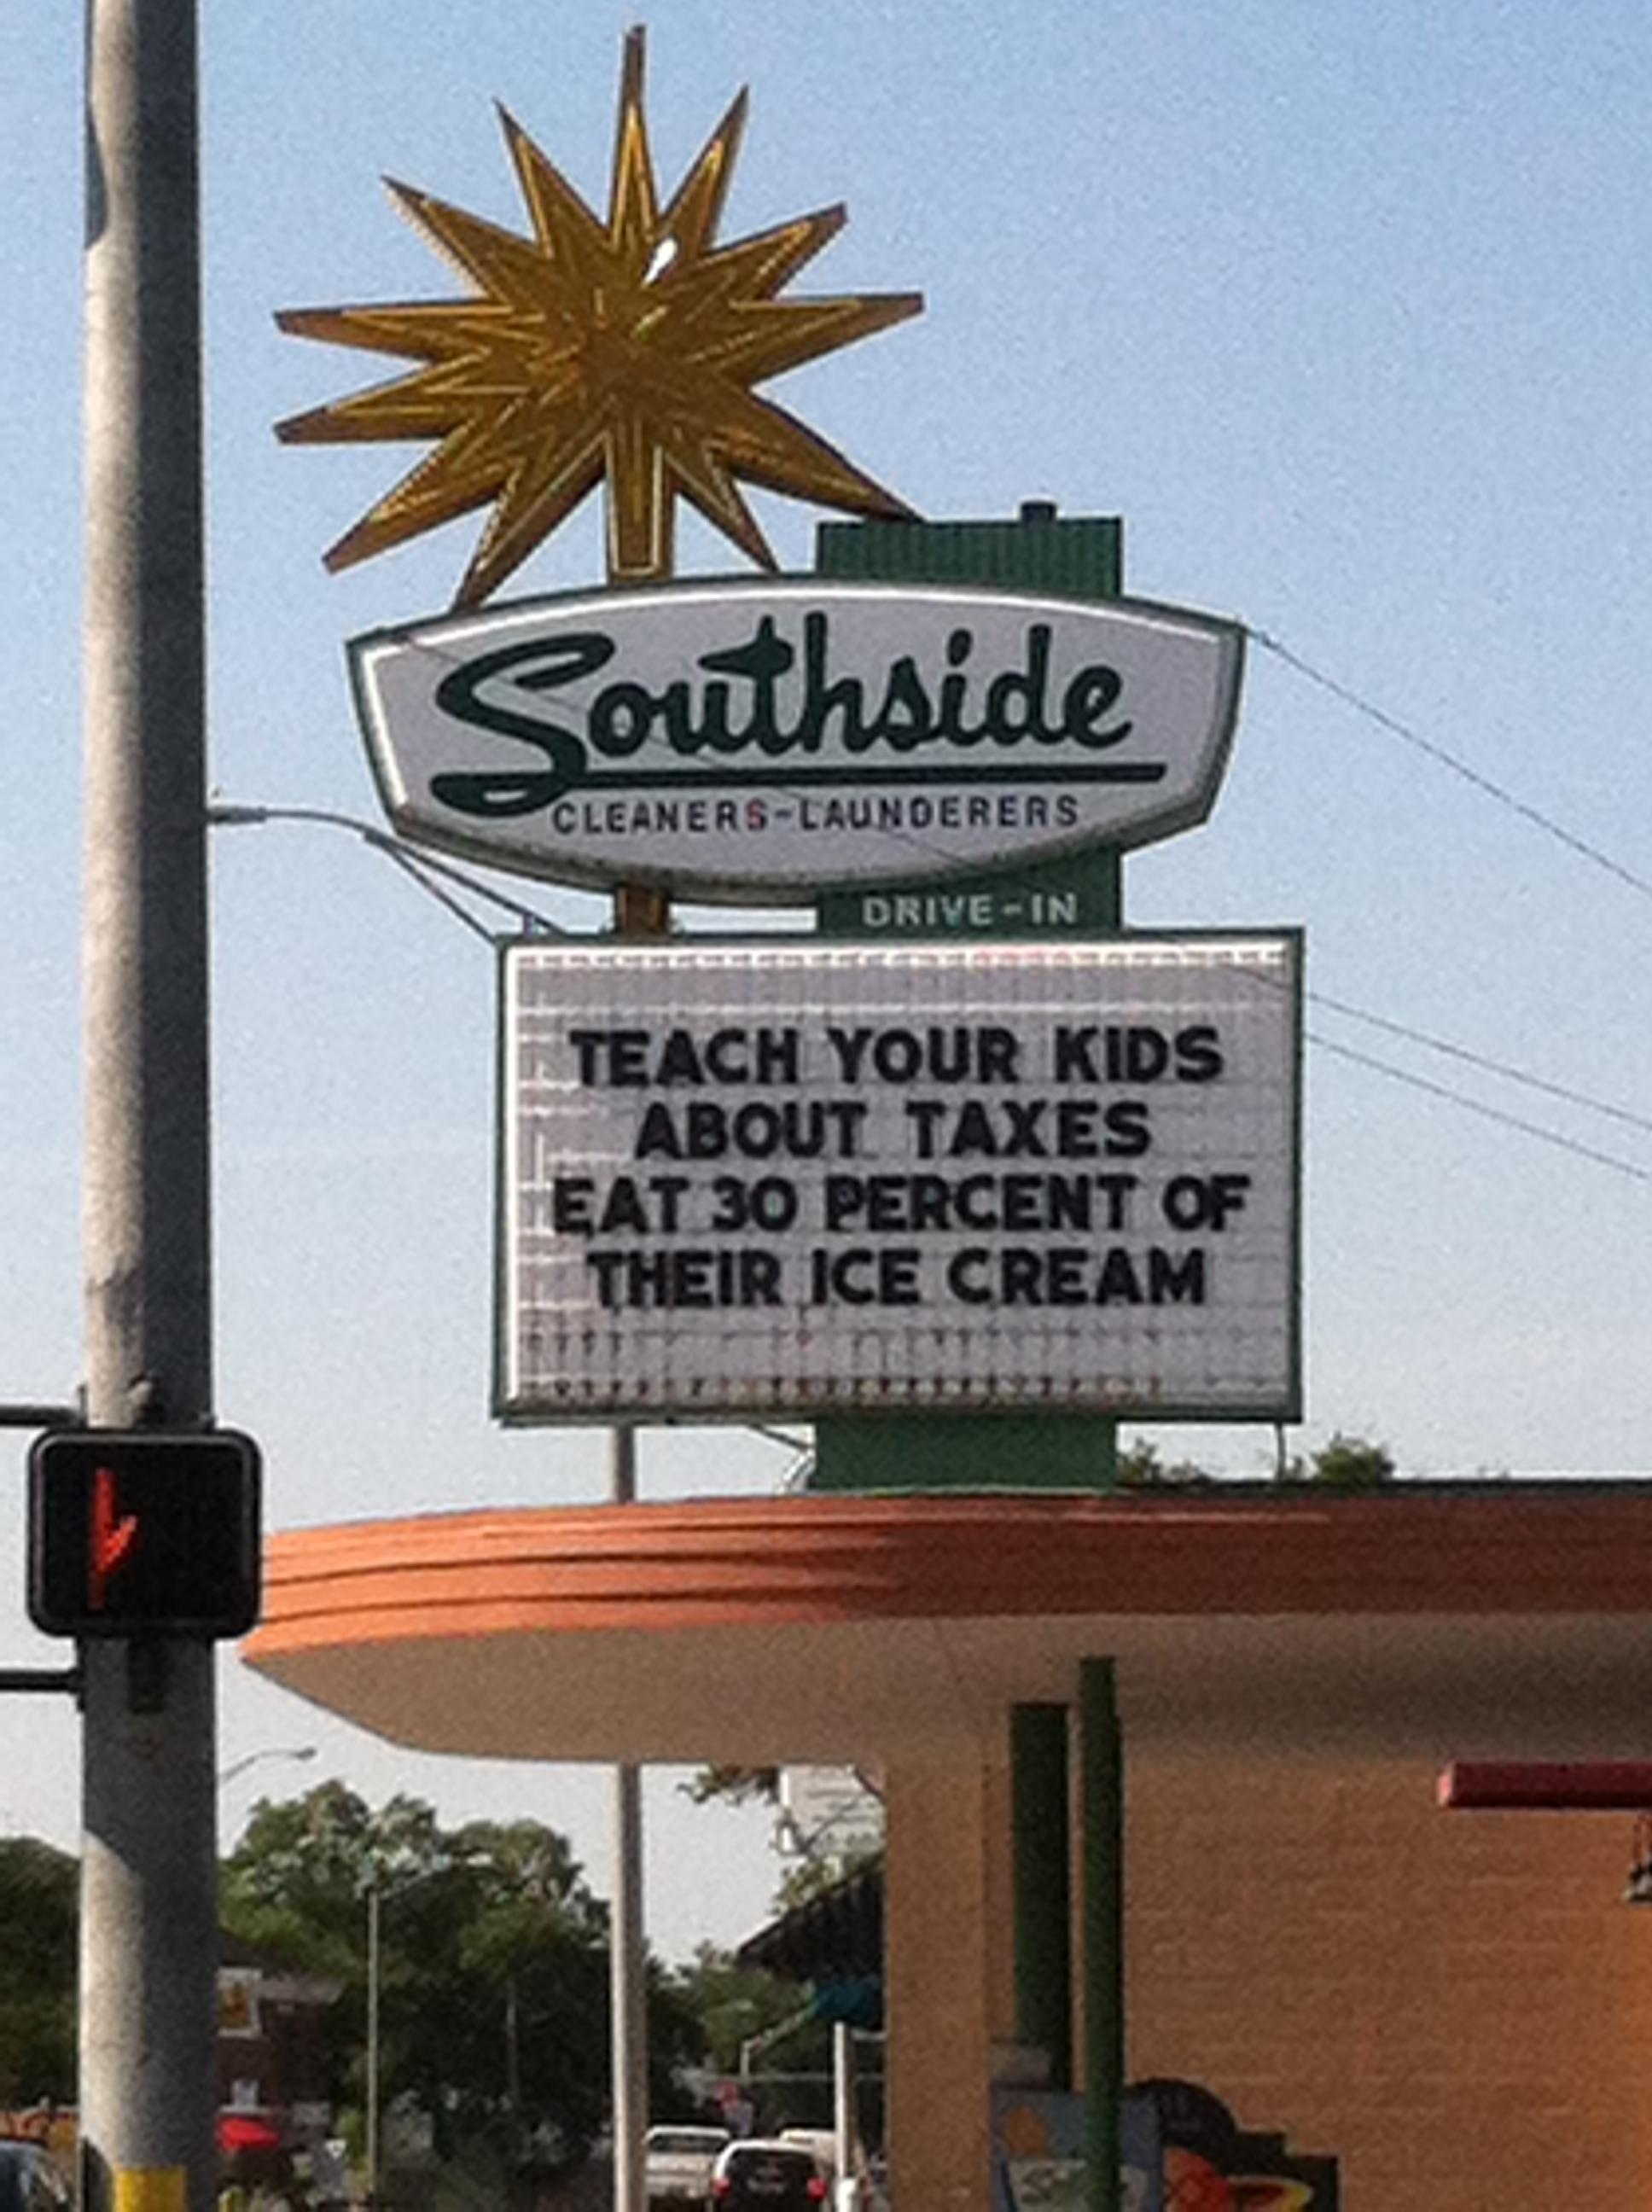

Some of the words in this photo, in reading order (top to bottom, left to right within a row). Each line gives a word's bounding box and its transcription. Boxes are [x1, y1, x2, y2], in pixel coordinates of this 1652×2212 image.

[430, 611, 1137, 818] Southside
[862, 892, 1078, 928] DRIVE-IN
[568, 1027, 799, 1087] TEACH
[827, 1027, 1019, 1084] YOUR
[1055, 1027, 1224, 1083] KIDS
[634, 1102, 867, 1160] ABOUT
[905, 1101, 1152, 1158] TAXES
[552, 1177, 689, 1234] EAT
[712, 1178, 798, 1232] 30
[824, 1176, 1137, 1232] PERCENT
[1163, 1176, 1251, 1231] OF
[586, 1249, 783, 1307] THEIR
[811, 1249, 922, 1307] ICE
[948, 1248, 1207, 1306] CREAM
